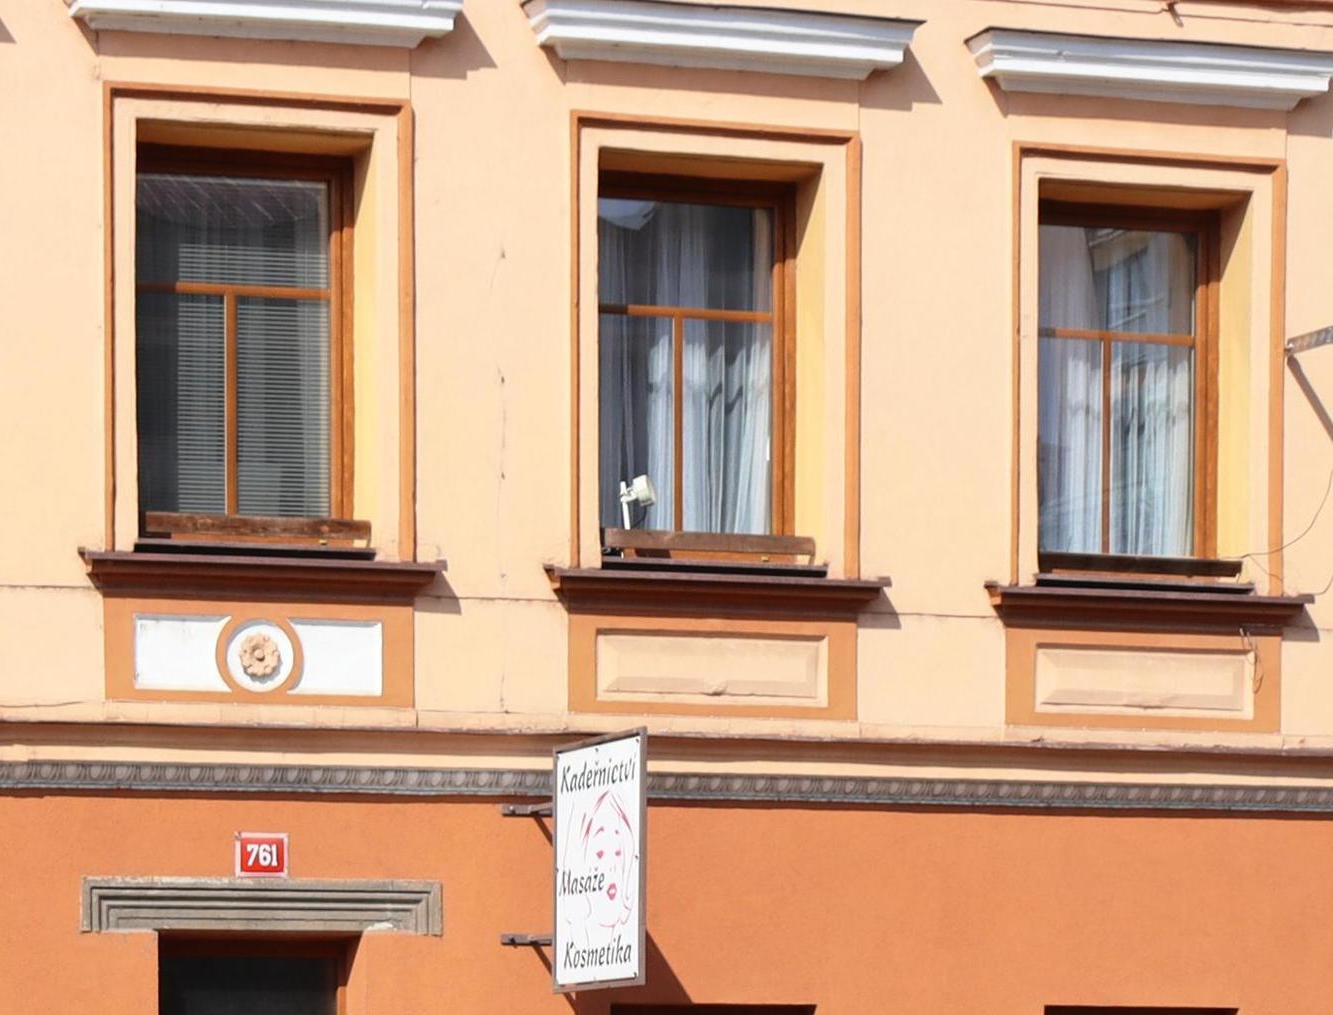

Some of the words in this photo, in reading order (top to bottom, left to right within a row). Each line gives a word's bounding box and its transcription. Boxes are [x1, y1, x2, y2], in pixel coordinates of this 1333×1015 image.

[560, 753, 637, 793] Kadeřnictví
[246, 843, 278, 867] 761
[564, 934, 632, 969] Kosmetika
